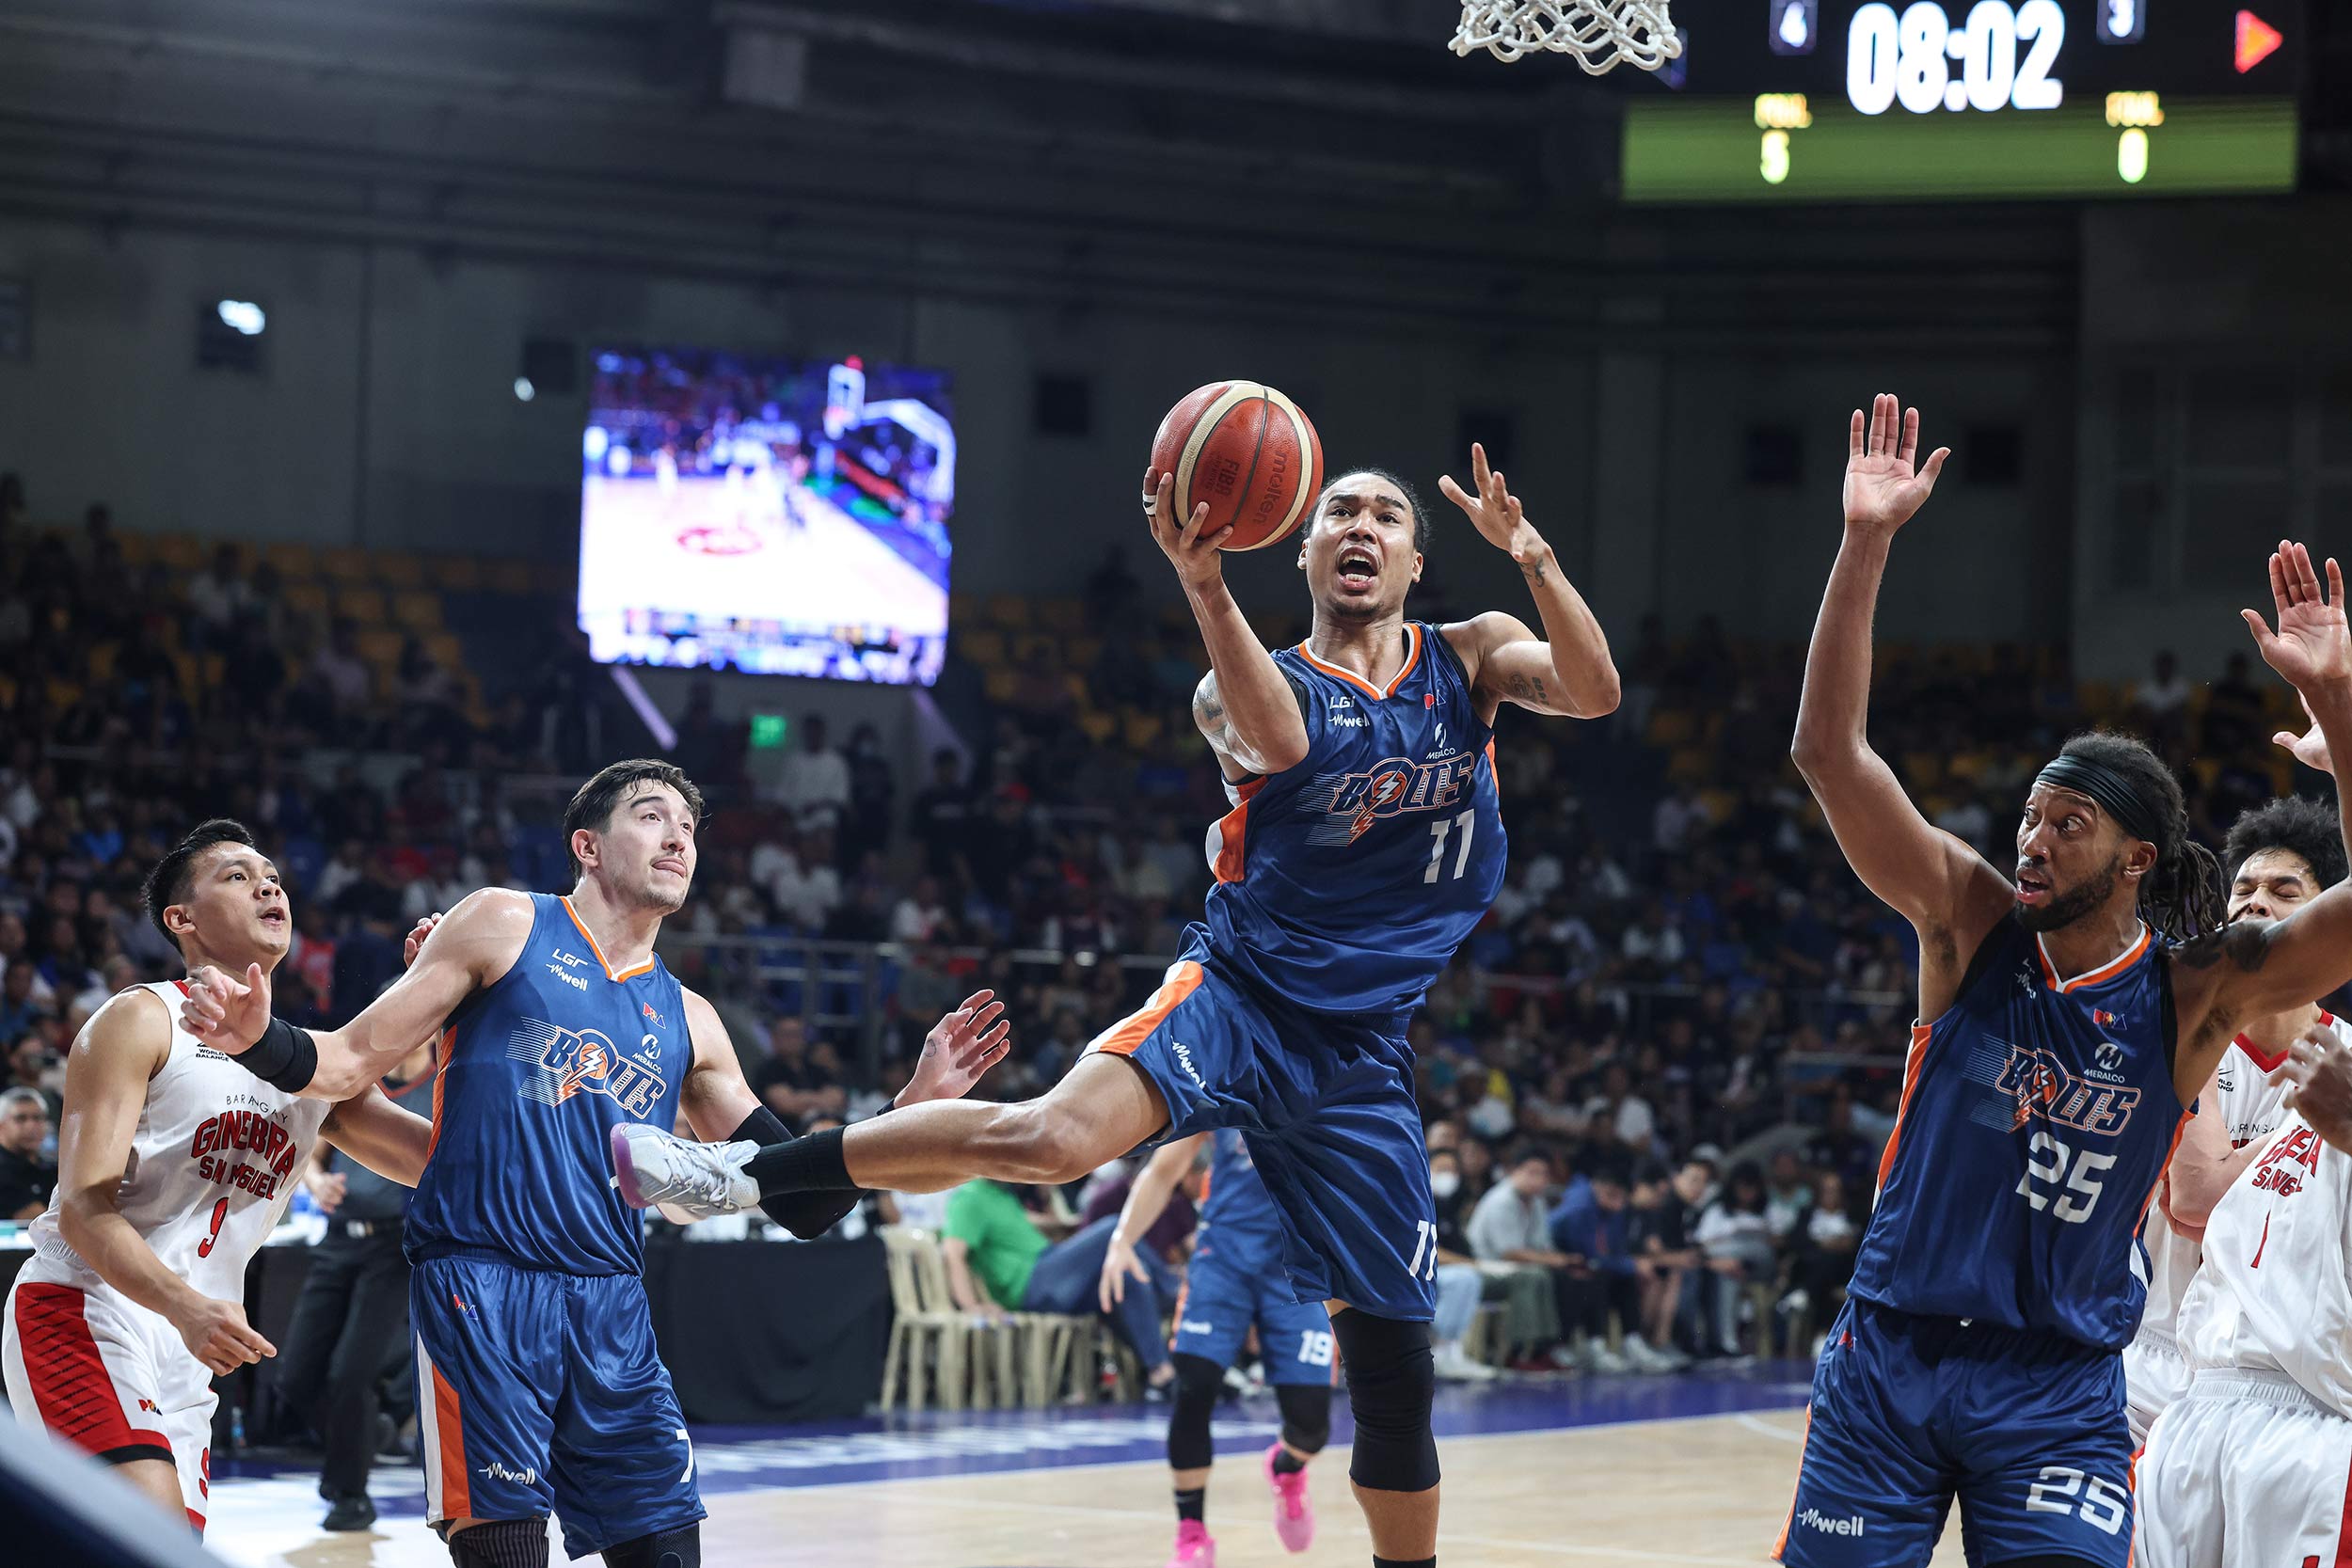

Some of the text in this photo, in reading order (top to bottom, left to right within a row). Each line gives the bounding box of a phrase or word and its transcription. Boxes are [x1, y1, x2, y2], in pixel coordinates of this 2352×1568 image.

[1847, 0, 2065, 115] 08:02
[1423, 808, 1475, 884] 11
[195, 1053, 230, 1062] BALANCE
[539, 1024, 667, 1120] BOLTS
[631, 1053, 662, 1074] MERALCO
[2083, 1068, 2126, 1085] MERALCO
[226, 1093, 288, 1124] BARANGAY
[191, 1110, 296, 1190] GINEBRA
[2015, 1131, 2118, 1223] 25
[1798, 1508, 1864, 1537] Mwell
[2026, 1465, 2127, 1536] 25
